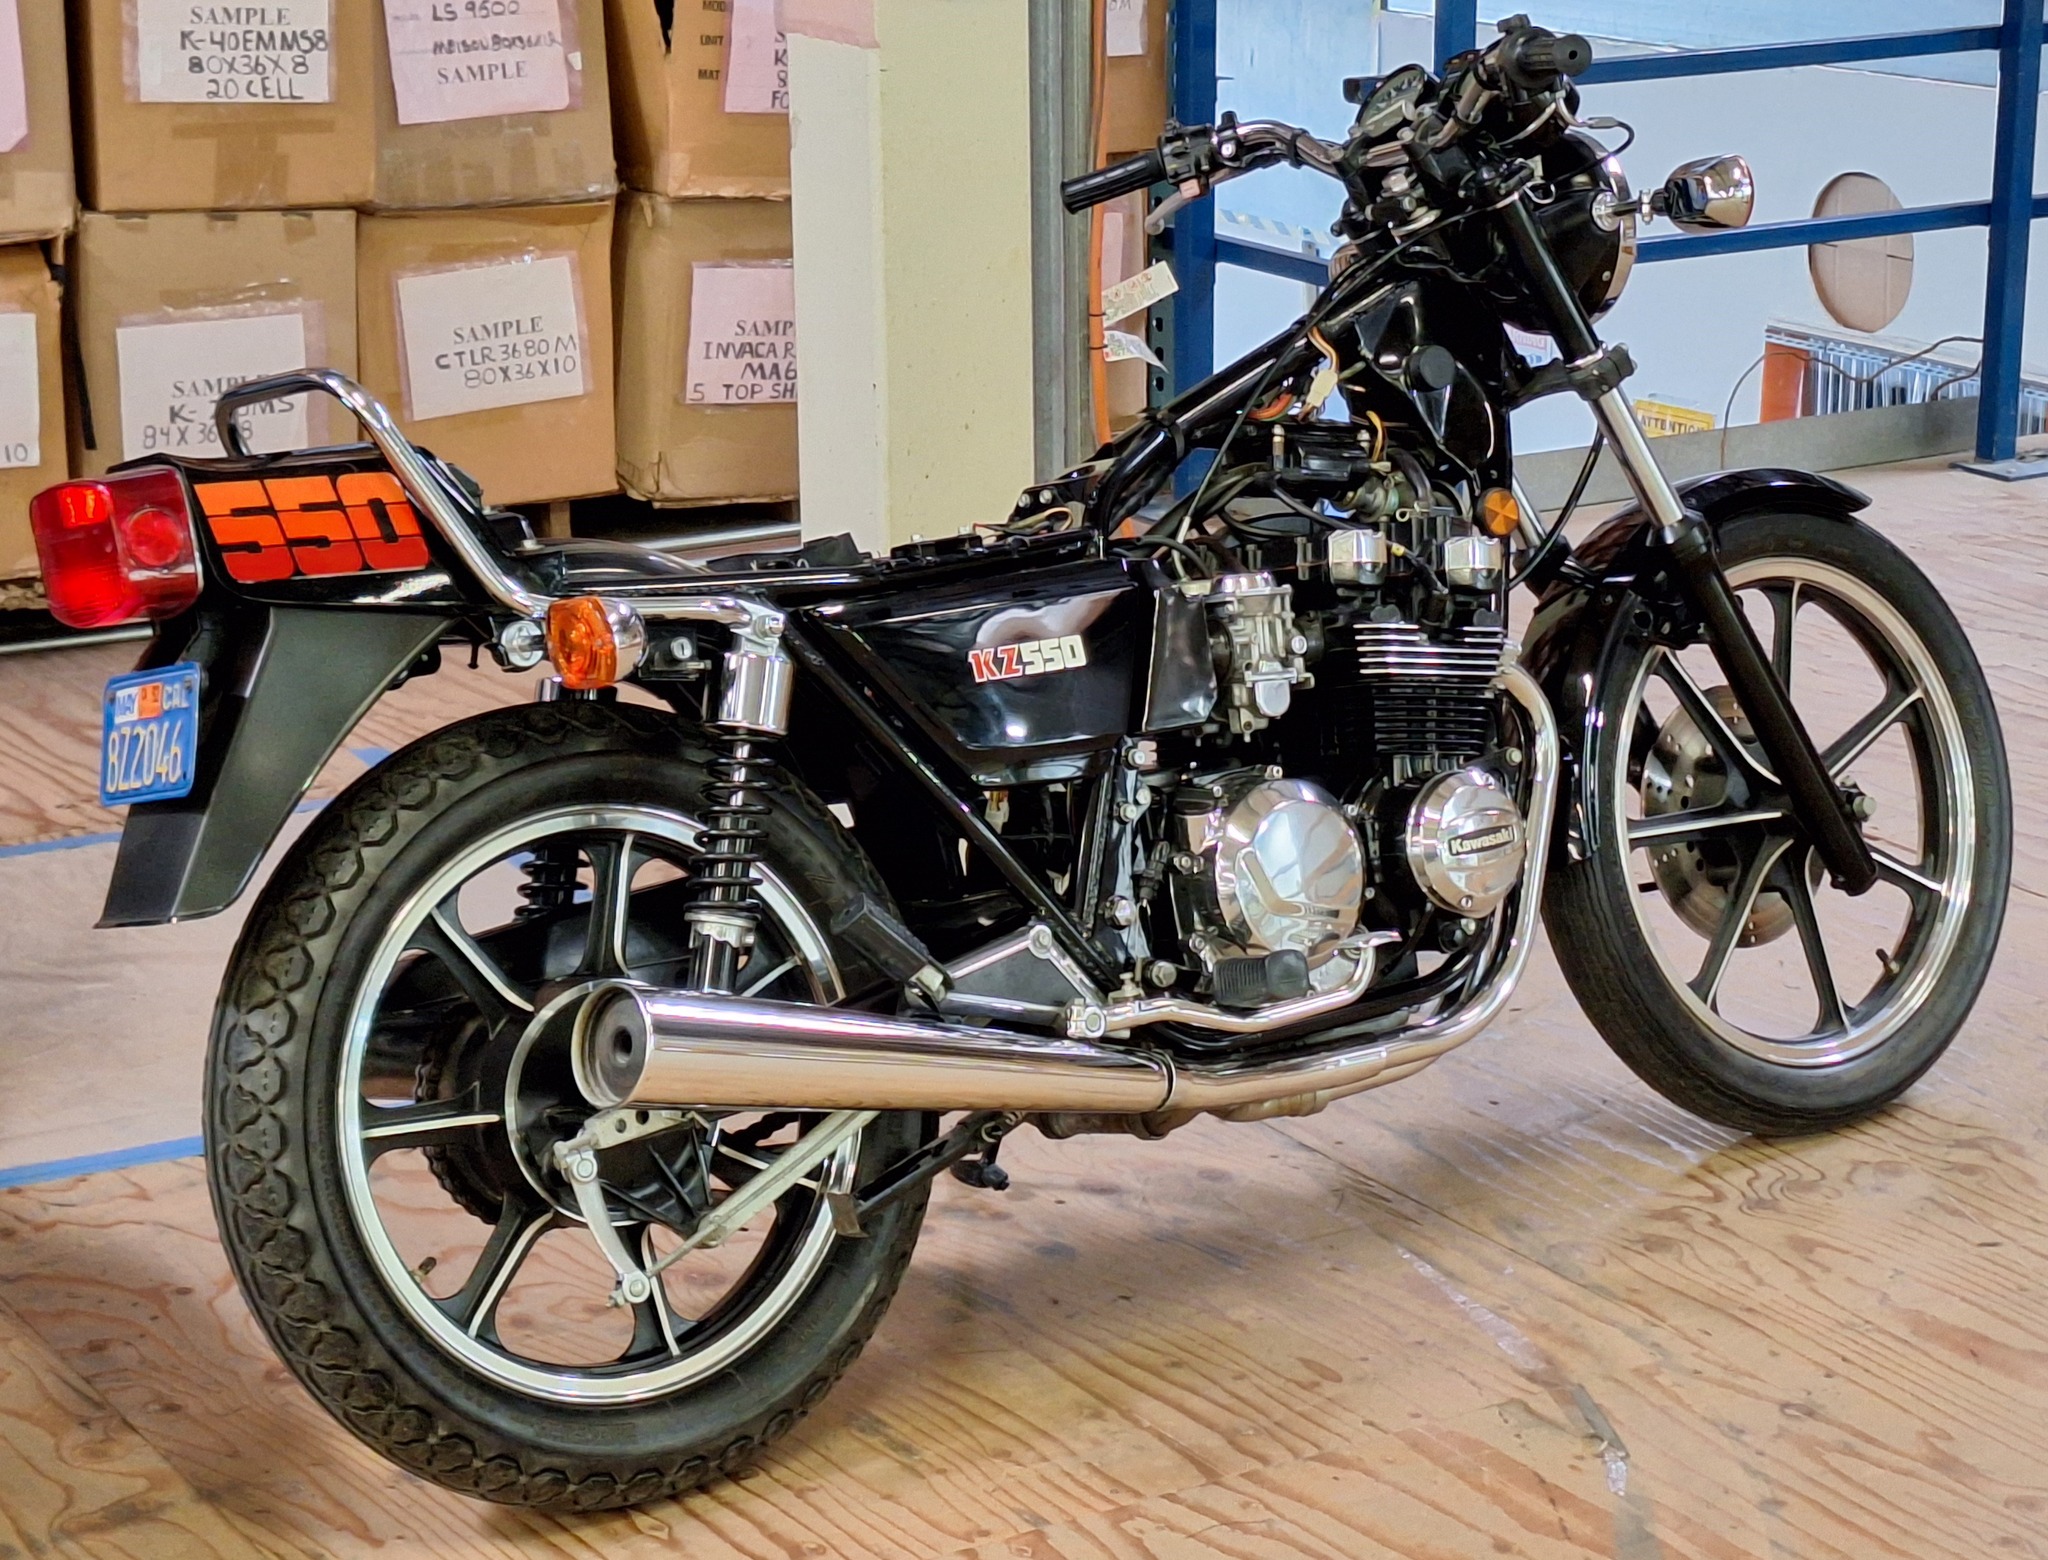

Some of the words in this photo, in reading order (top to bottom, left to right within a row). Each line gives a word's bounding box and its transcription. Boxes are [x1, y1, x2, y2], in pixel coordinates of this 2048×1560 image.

[190, 6, 291, 26] SAMPLE
[437, 61, 527, 85] SAMPLE
[206, 78, 240, 99] 20
[246, 76, 304, 100] CELL
[453, 316, 544, 345] SAMPLE
[734, 319, 794, 337] SAMP
[722, 382, 764, 401] TOP
[769, 382, 798, 400] SH
[1641, 414, 1706, 435] ATTENTIO
[194, 471, 430, 584] 550
[968, 634, 1088, 683] KZ550
[1451, 826, 1514, 855] Kawasaki
